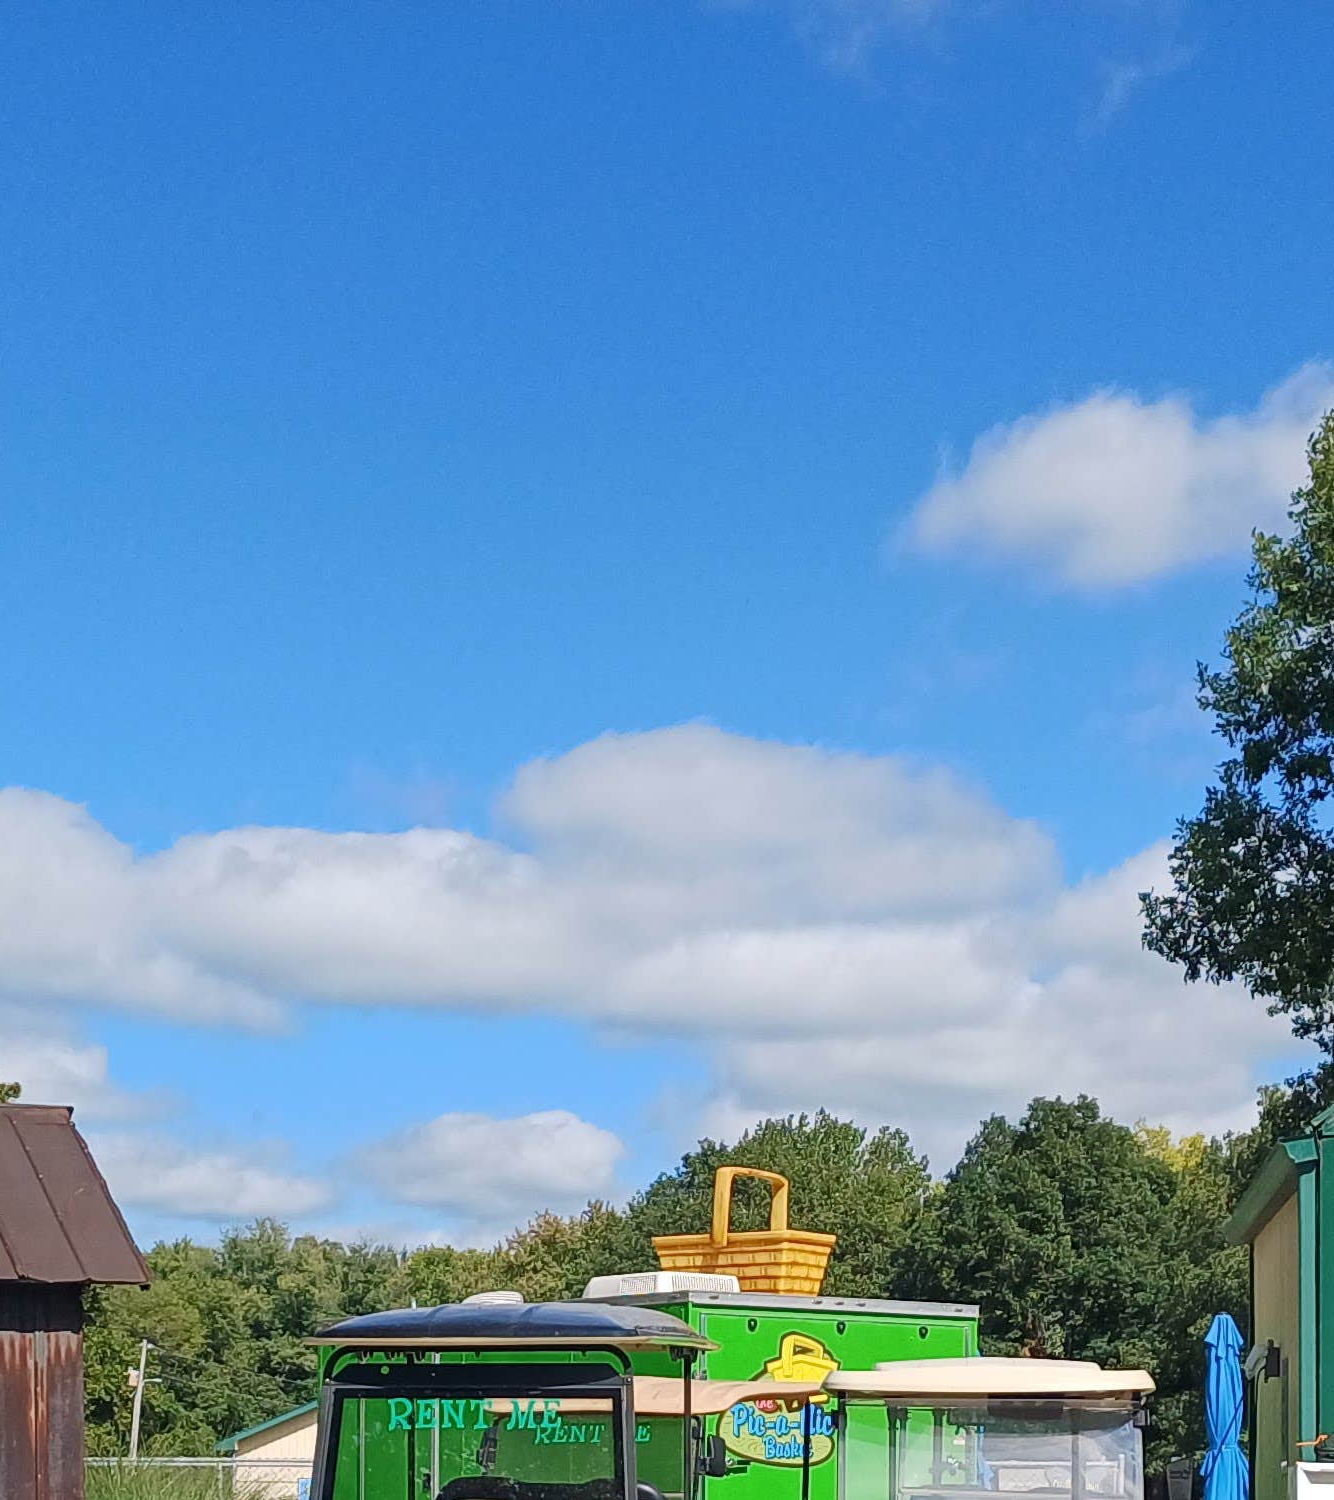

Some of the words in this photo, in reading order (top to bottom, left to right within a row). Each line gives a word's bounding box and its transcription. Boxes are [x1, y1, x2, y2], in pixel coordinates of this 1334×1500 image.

[387, 1398, 493, 1431] RENT
[506, 1399, 565, 1430] ME
[535, 1423, 605, 1445] RENT
